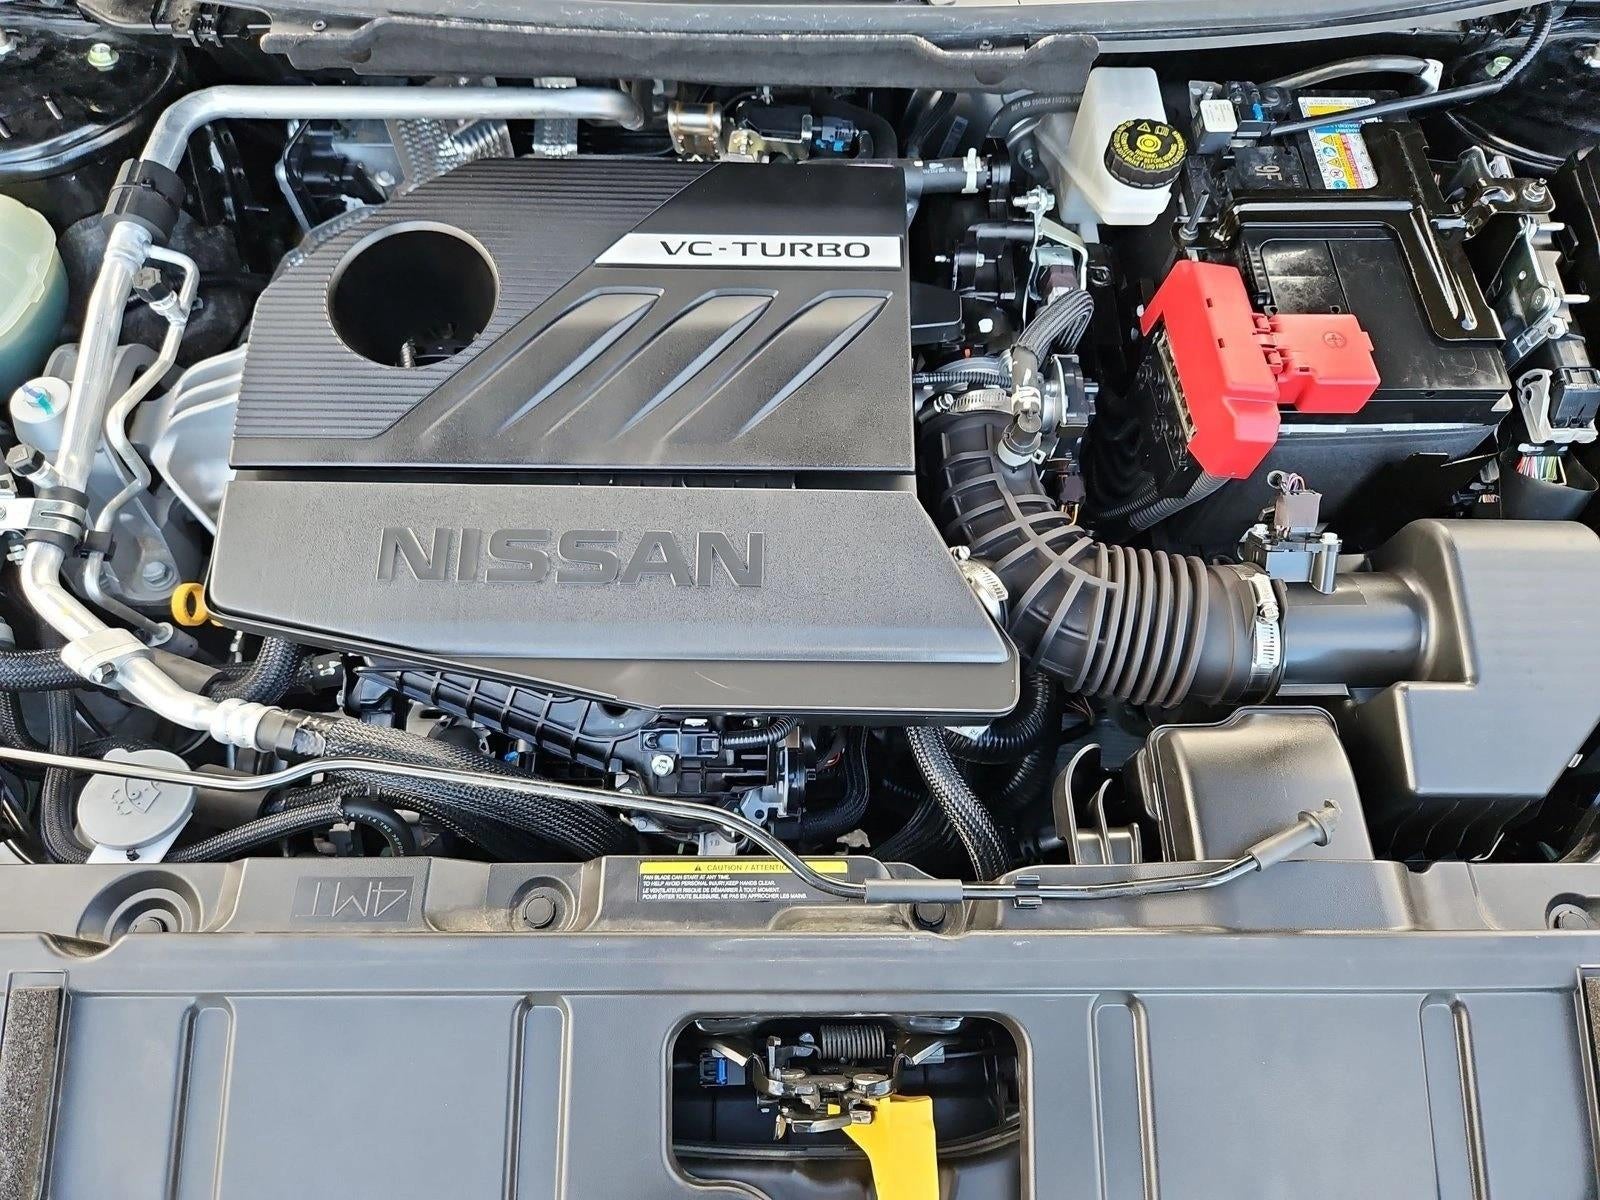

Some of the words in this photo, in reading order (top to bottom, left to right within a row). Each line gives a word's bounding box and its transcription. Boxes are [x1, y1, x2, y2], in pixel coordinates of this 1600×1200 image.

[1255, 165, 1282, 181] 9F
[660, 240, 871, 259] VC-TURBO
[376, 527, 764, 588] NISSAN
[706, 864, 742, 872] CAUTION
[750, 864, 788, 872] ATTENTIO
[296, 881, 408, 918] 4MT
